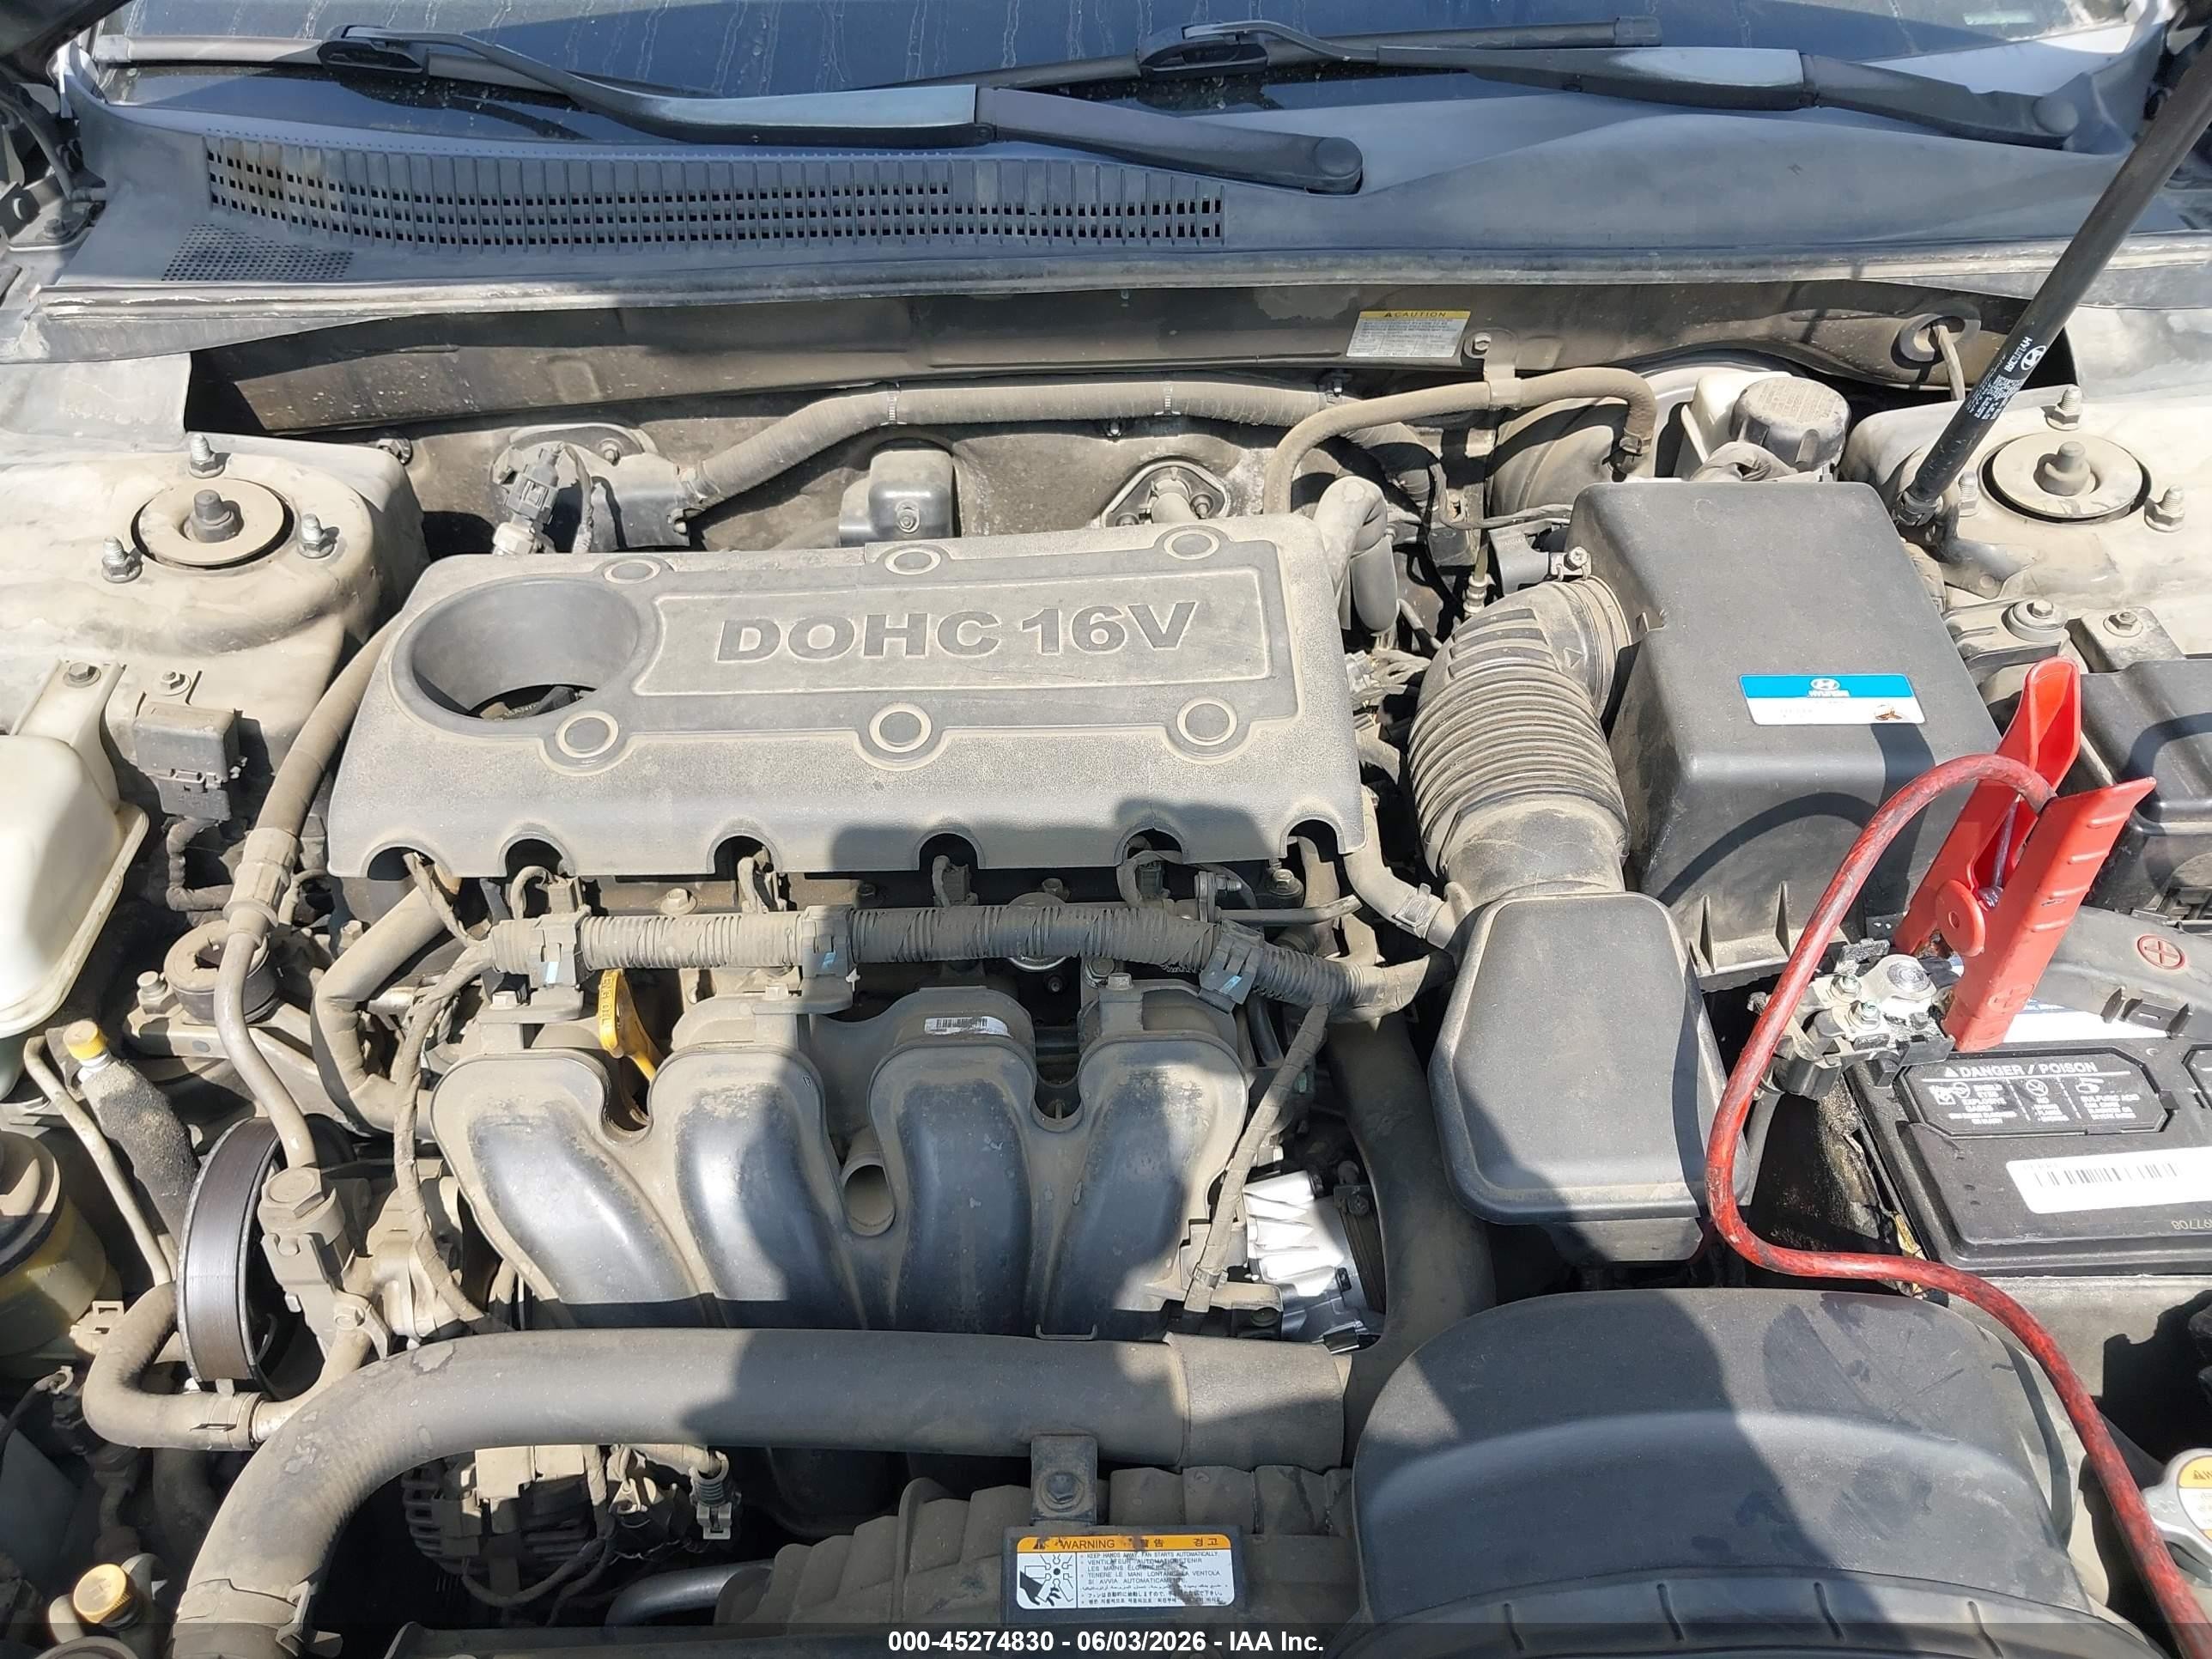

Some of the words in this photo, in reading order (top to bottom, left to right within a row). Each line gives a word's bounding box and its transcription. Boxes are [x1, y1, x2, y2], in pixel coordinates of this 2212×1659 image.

[2004, 337, 2033, 373] HYUNDAI
[714, 611, 1002, 663] DOHC
[1022, 601, 1198, 656] 16V
[600, 976, 613, 1000] ENG
[599, 1003, 611, 1026] OIL
[1959, 1064, 2026, 1077] DANGER
[2038, 1061, 2099, 1074] POISON
[1060, 1539, 1115, 1550] WARNING
